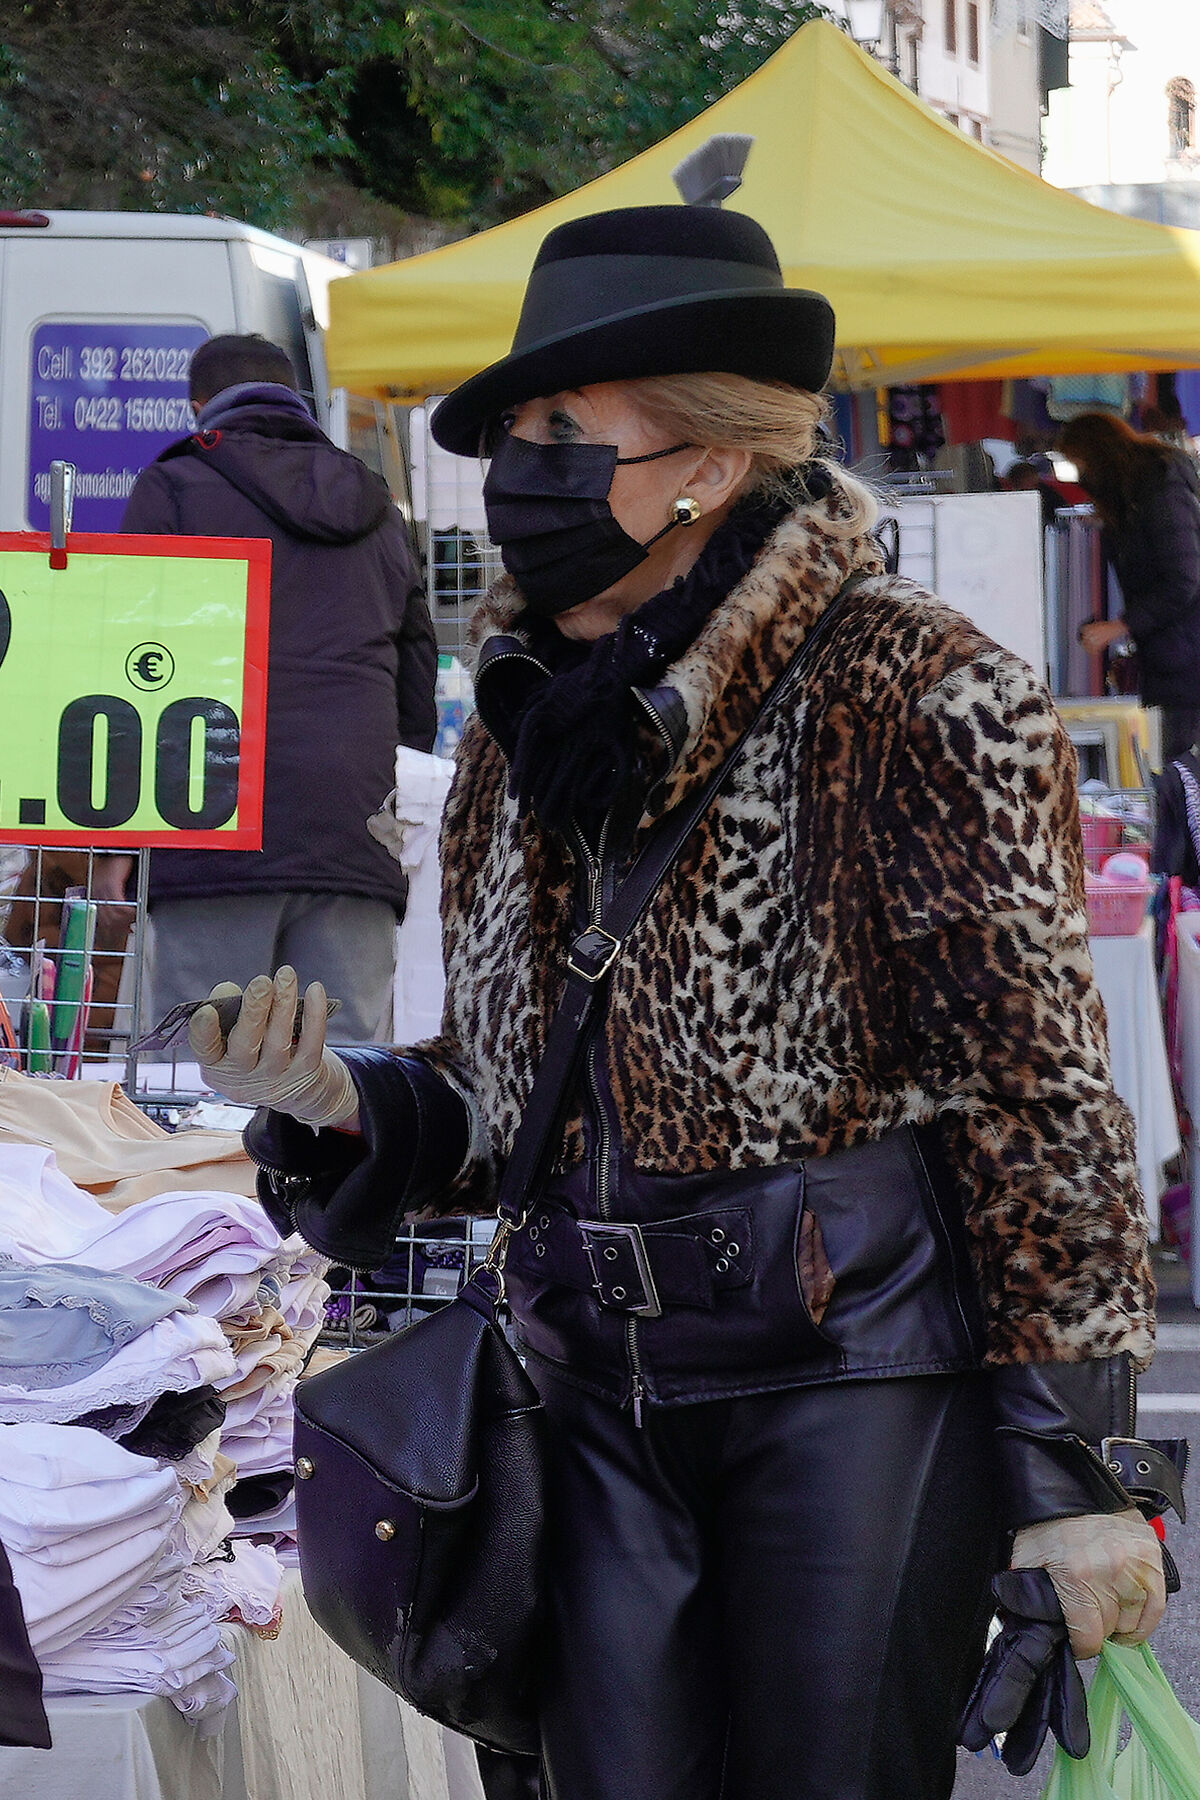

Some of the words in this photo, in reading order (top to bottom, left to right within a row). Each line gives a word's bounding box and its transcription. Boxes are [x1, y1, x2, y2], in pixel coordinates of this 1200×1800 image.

[37, 345, 73, 382] Cell.
[79, 346, 115, 381] 392
[120, 347, 195, 382] 262022
[36, 396, 64, 431] Tel.
[74, 397, 121, 431] 0422
